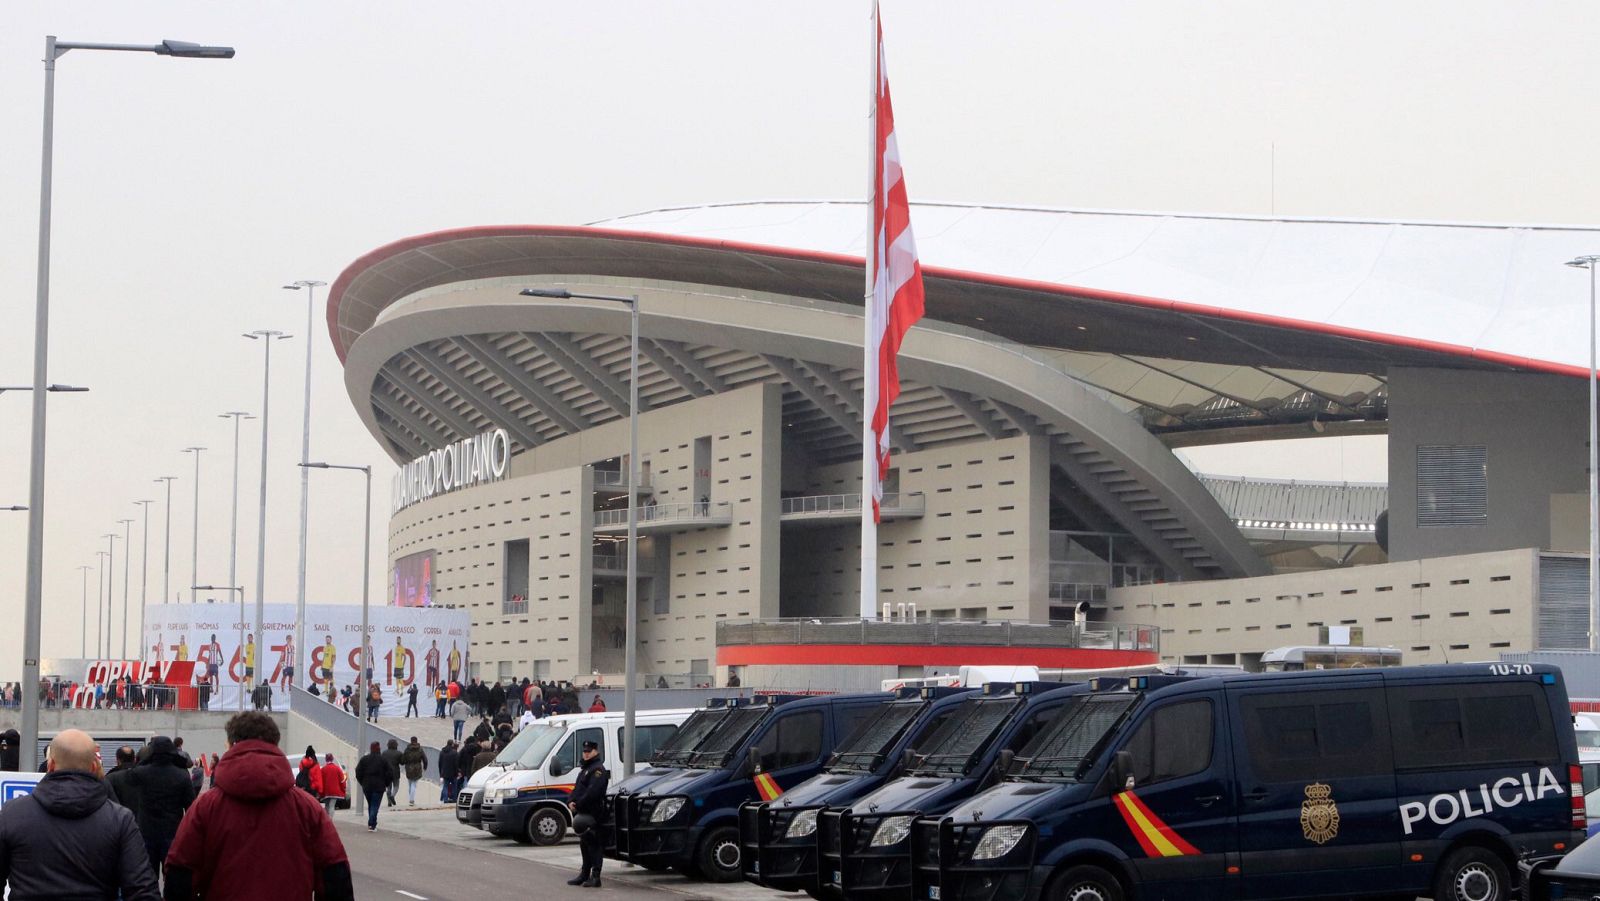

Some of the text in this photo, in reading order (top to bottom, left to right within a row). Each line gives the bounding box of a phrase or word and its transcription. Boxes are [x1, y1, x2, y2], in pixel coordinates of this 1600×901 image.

[408, 428, 510, 507] METROPOLITANO
[261, 623, 296, 631] GRIEZMAN
[384, 625, 415, 634] CARRASCO
[1489, 664, 1533, 676] 1U-70
[1399, 766, 1565, 835] POLICIA
